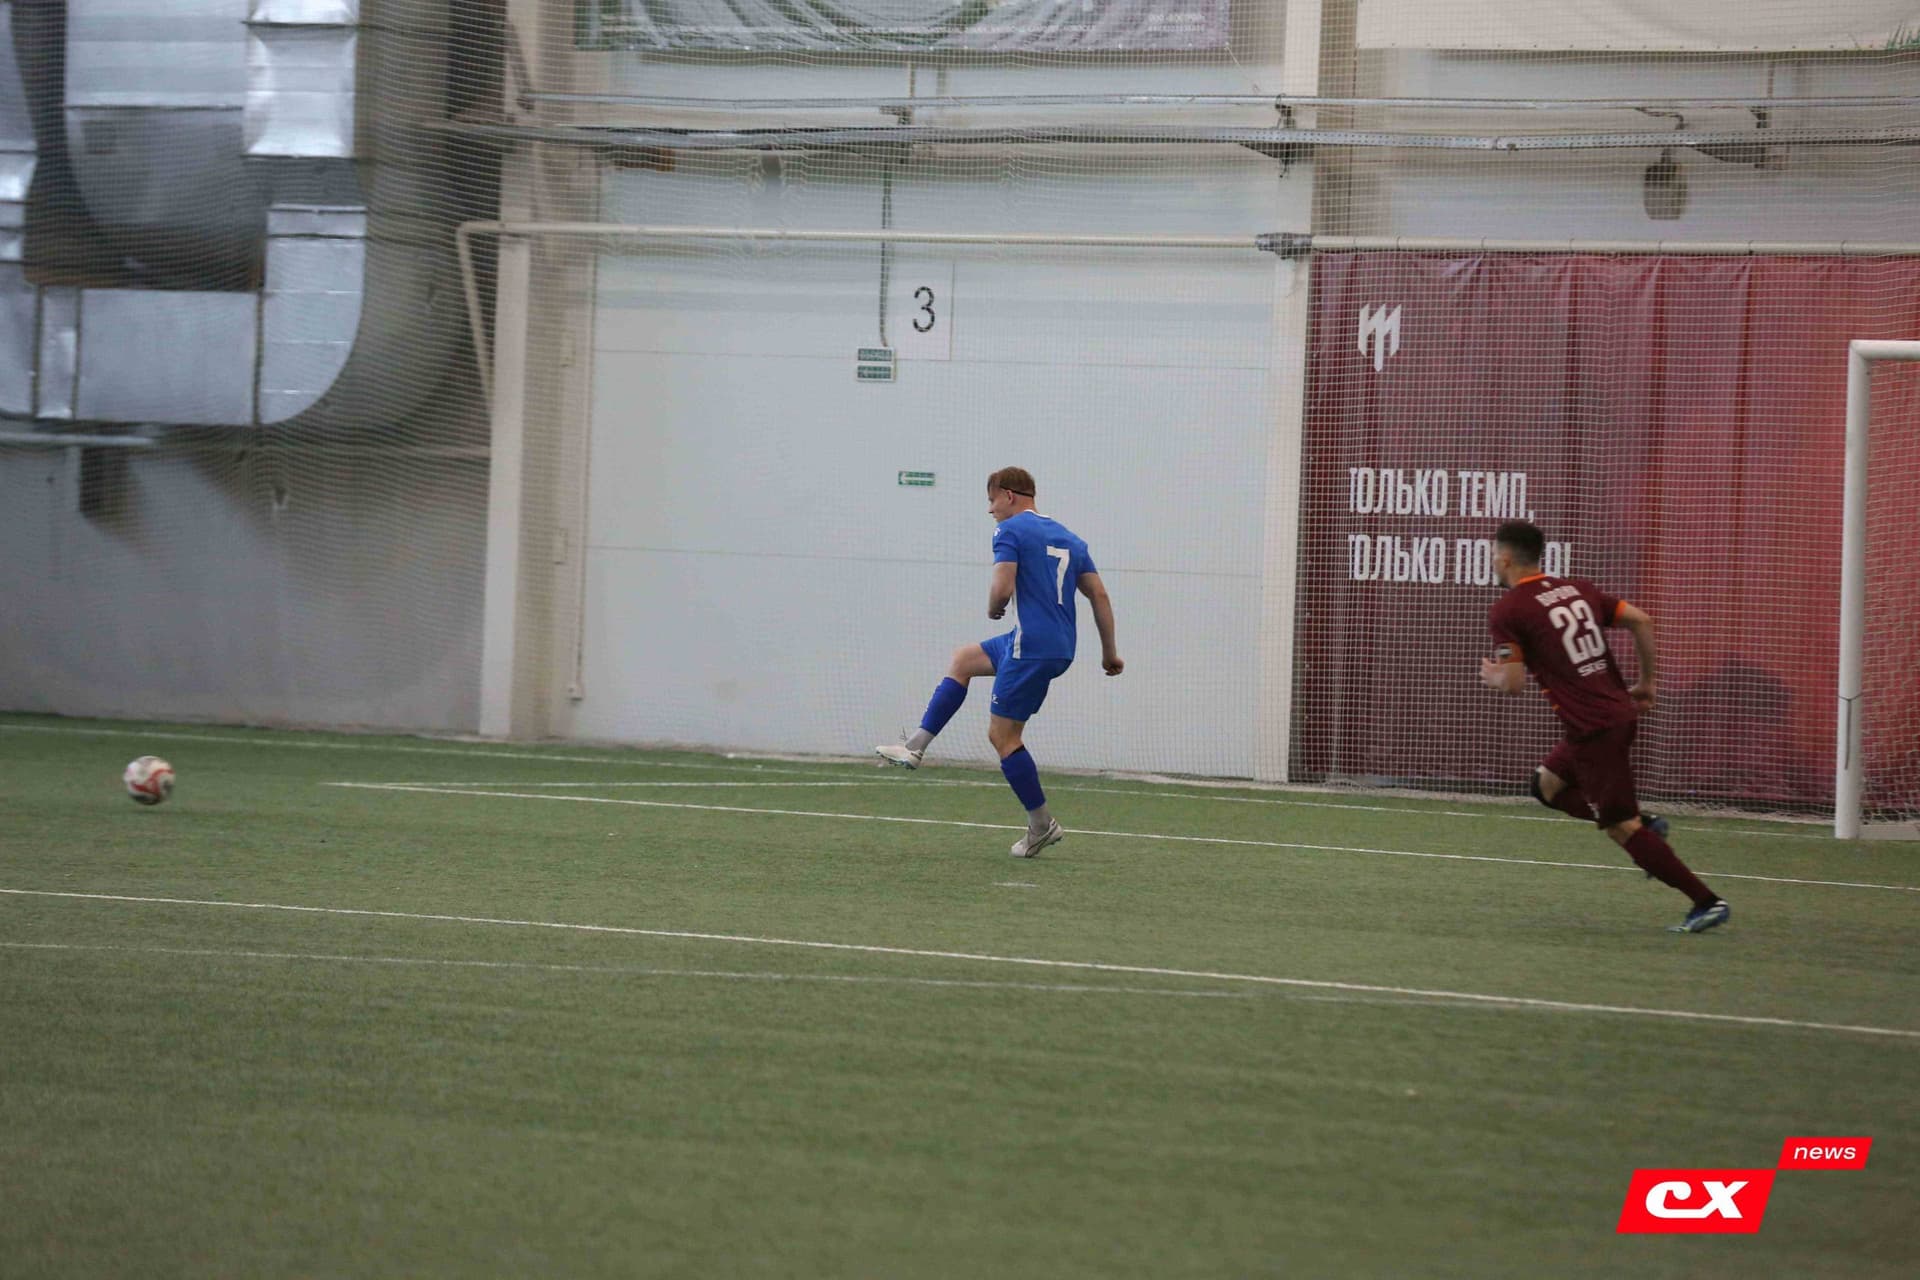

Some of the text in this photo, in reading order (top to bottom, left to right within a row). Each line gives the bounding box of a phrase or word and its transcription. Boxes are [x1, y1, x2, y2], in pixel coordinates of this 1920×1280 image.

[913, 286, 935, 333] 3
[1457, 471, 1535, 524] ТЕМП,
[1046, 545, 1070, 605] 7
[1548, 599, 1606, 665] 23
